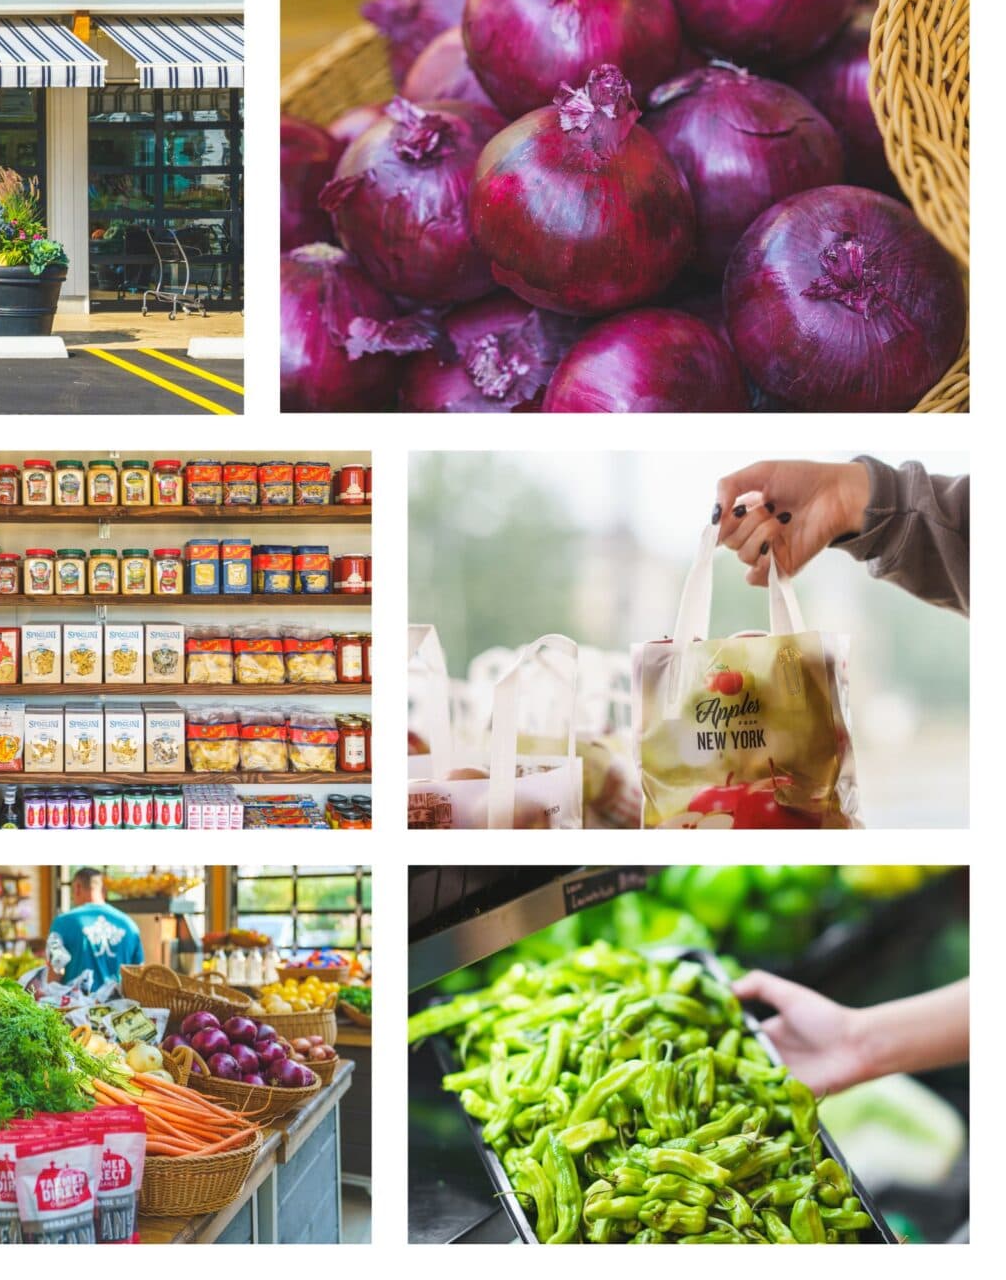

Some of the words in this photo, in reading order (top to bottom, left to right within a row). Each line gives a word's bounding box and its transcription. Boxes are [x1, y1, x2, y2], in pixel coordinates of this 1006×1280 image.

[696, 691, 760, 729] Apples
[697, 731, 726, 750] NEW
[730, 729, 767, 749] YORK
[39, 1173, 85, 1191] FARMER
[42, 1184, 84, 1203] DIRECT
